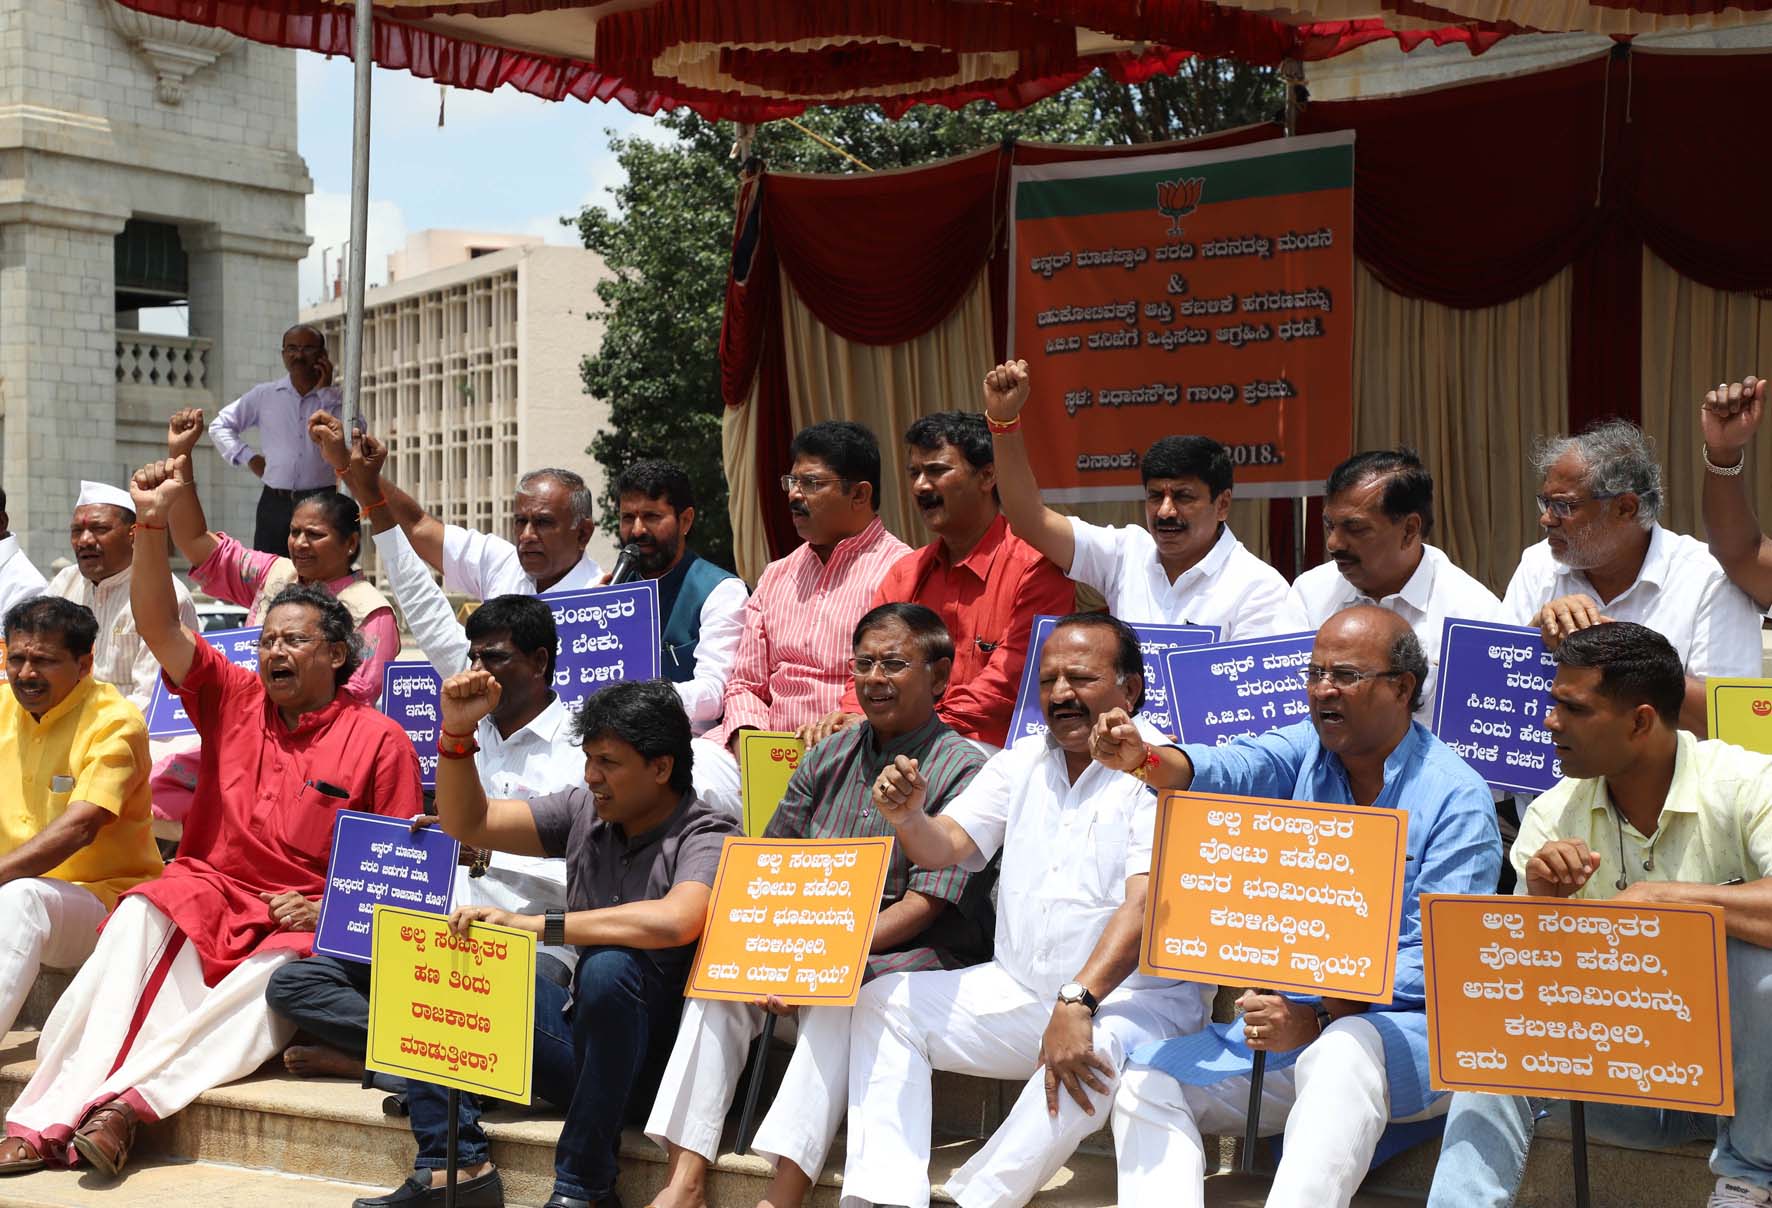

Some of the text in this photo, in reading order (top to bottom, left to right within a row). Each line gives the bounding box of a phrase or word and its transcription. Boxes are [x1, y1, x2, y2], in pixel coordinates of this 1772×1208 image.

[1202, 238, 1270, 257] ಸದನದಲ್ಲಿ
[1279, 228, 1333, 250] ಮಂಡನೆ
[1167, 273, 1184, 293] &
[1242, 289, 1330, 312] ಹಗರಣವನ್ನು
[1099, 383, 1178, 405] ವಿಧಾನಸೌಧ
[1187, 383, 1234, 404] ಗಾಂಧಿ
[1077, 452, 1136, 469] ದಿನಾಂಕ:
[572, 631, 623, 654] ಬೇಕು,
[1488, 644, 1533, 669] ಅನ್ವರ್
[1211, 656, 1255, 682] ಅನ್ವರ್
[405, 702, 436, 721] ಇನ್ನೂ
[1205, 708, 1256, 726] ಸಿ.ಬಿ.ಐ.
[1262, 701, 1277, 719] ಗೆ
[1524, 699, 1538, 716] ಗೆ
[1470, 718, 1512, 738] ಎಂದು
[1506, 748, 1545, 769] ವಚನ
[1207, 809, 1354, 845] ಅಲ್ಪ ಸಂಖ್ಯಾತರ
[757, 850, 858, 876] ಅಲ್ಪ ಸಂಖ್ಯಾತರ
[1200, 838, 1355, 875] ವೋಟು ಪಡೆದಿರಿ,
[747, 877, 797, 899] ವೋಟು
[1180, 871, 1369, 918] ಅವರ ಭೂಮಿಯನ್ನು
[729, 905, 856, 932] ಅವರ ಭೂಮಿಯನ್ನು
[1210, 906, 1330, 944] ಕಬಳಿಸಿದ್ದೀರಿ,
[1482, 911, 1660, 947] ಅಲ್ಪ ಸಂಖ್ಯಾತರ
[400, 924, 508, 966] ಅಲ್ಪ ಸಂಖ್ಯಾತರ
[1164, 936, 1371, 983] ಇದು ಯಾವ ನ್ಯಾಯ?
[1479, 942, 1668, 976] ವೋಟು ಪಡೆದಿರಿ,
[415, 963, 491, 995] ಹಣ ತಿಂದು
[707, 962, 850, 993] ಇದು ಯಾವ ನ್ಯಾಯ?
[1463, 978, 1692, 1022] ಅವರ ಭೂಮಿಯನ್ನು
[411, 1001, 491, 1033] ರಾಜಕಾರಣ
[1505, 1015, 1650, 1052] ಕಬಳಿಸಿದ್ದೀರಿ,
[400, 1035, 498, 1072] ಮಾಡುತ್ತೀರಾ?
[1456, 1048, 1703, 1092] ಇದು ಯಾವ ನ್ಯಾಯ?
